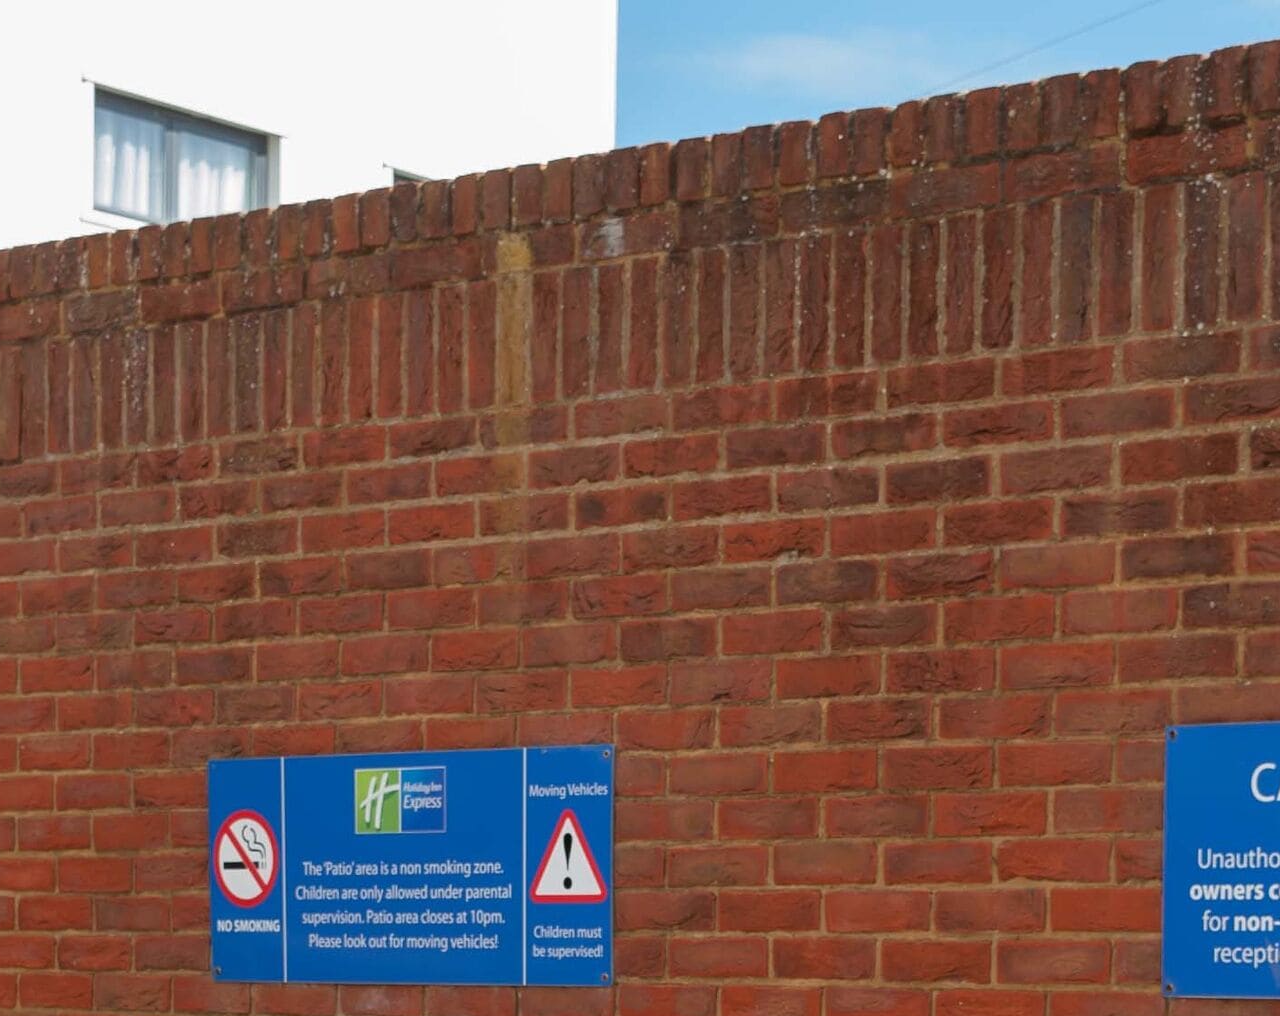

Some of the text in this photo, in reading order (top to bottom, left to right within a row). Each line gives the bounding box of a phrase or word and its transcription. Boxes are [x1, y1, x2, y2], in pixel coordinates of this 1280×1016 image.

[529, 783, 608, 799] Moving Vehicles
[404, 795, 442, 812] Express
[303, 861, 323, 876] The
[355, 864, 378, 875] area
[380, 861, 389, 875] is
[391, 864, 398, 875] a
[399, 864, 421, 875] non
[424, 860, 471, 878] smoking
[473, 862, 503, 874] zone.
[295, 884, 512, 903] Children are only allowed under parental
[1190, 884, 1264, 900] owners
[217, 920, 280, 932] NO SMOKING
[302, 909, 505, 927] supervision. Patio area closes at 10pm.
[1202, 909, 1230, 931] for
[533, 925, 602, 938] Children must
[309, 933, 499, 952] Please look out for moving vehicles!
[533, 944, 603, 960] be supervised!
